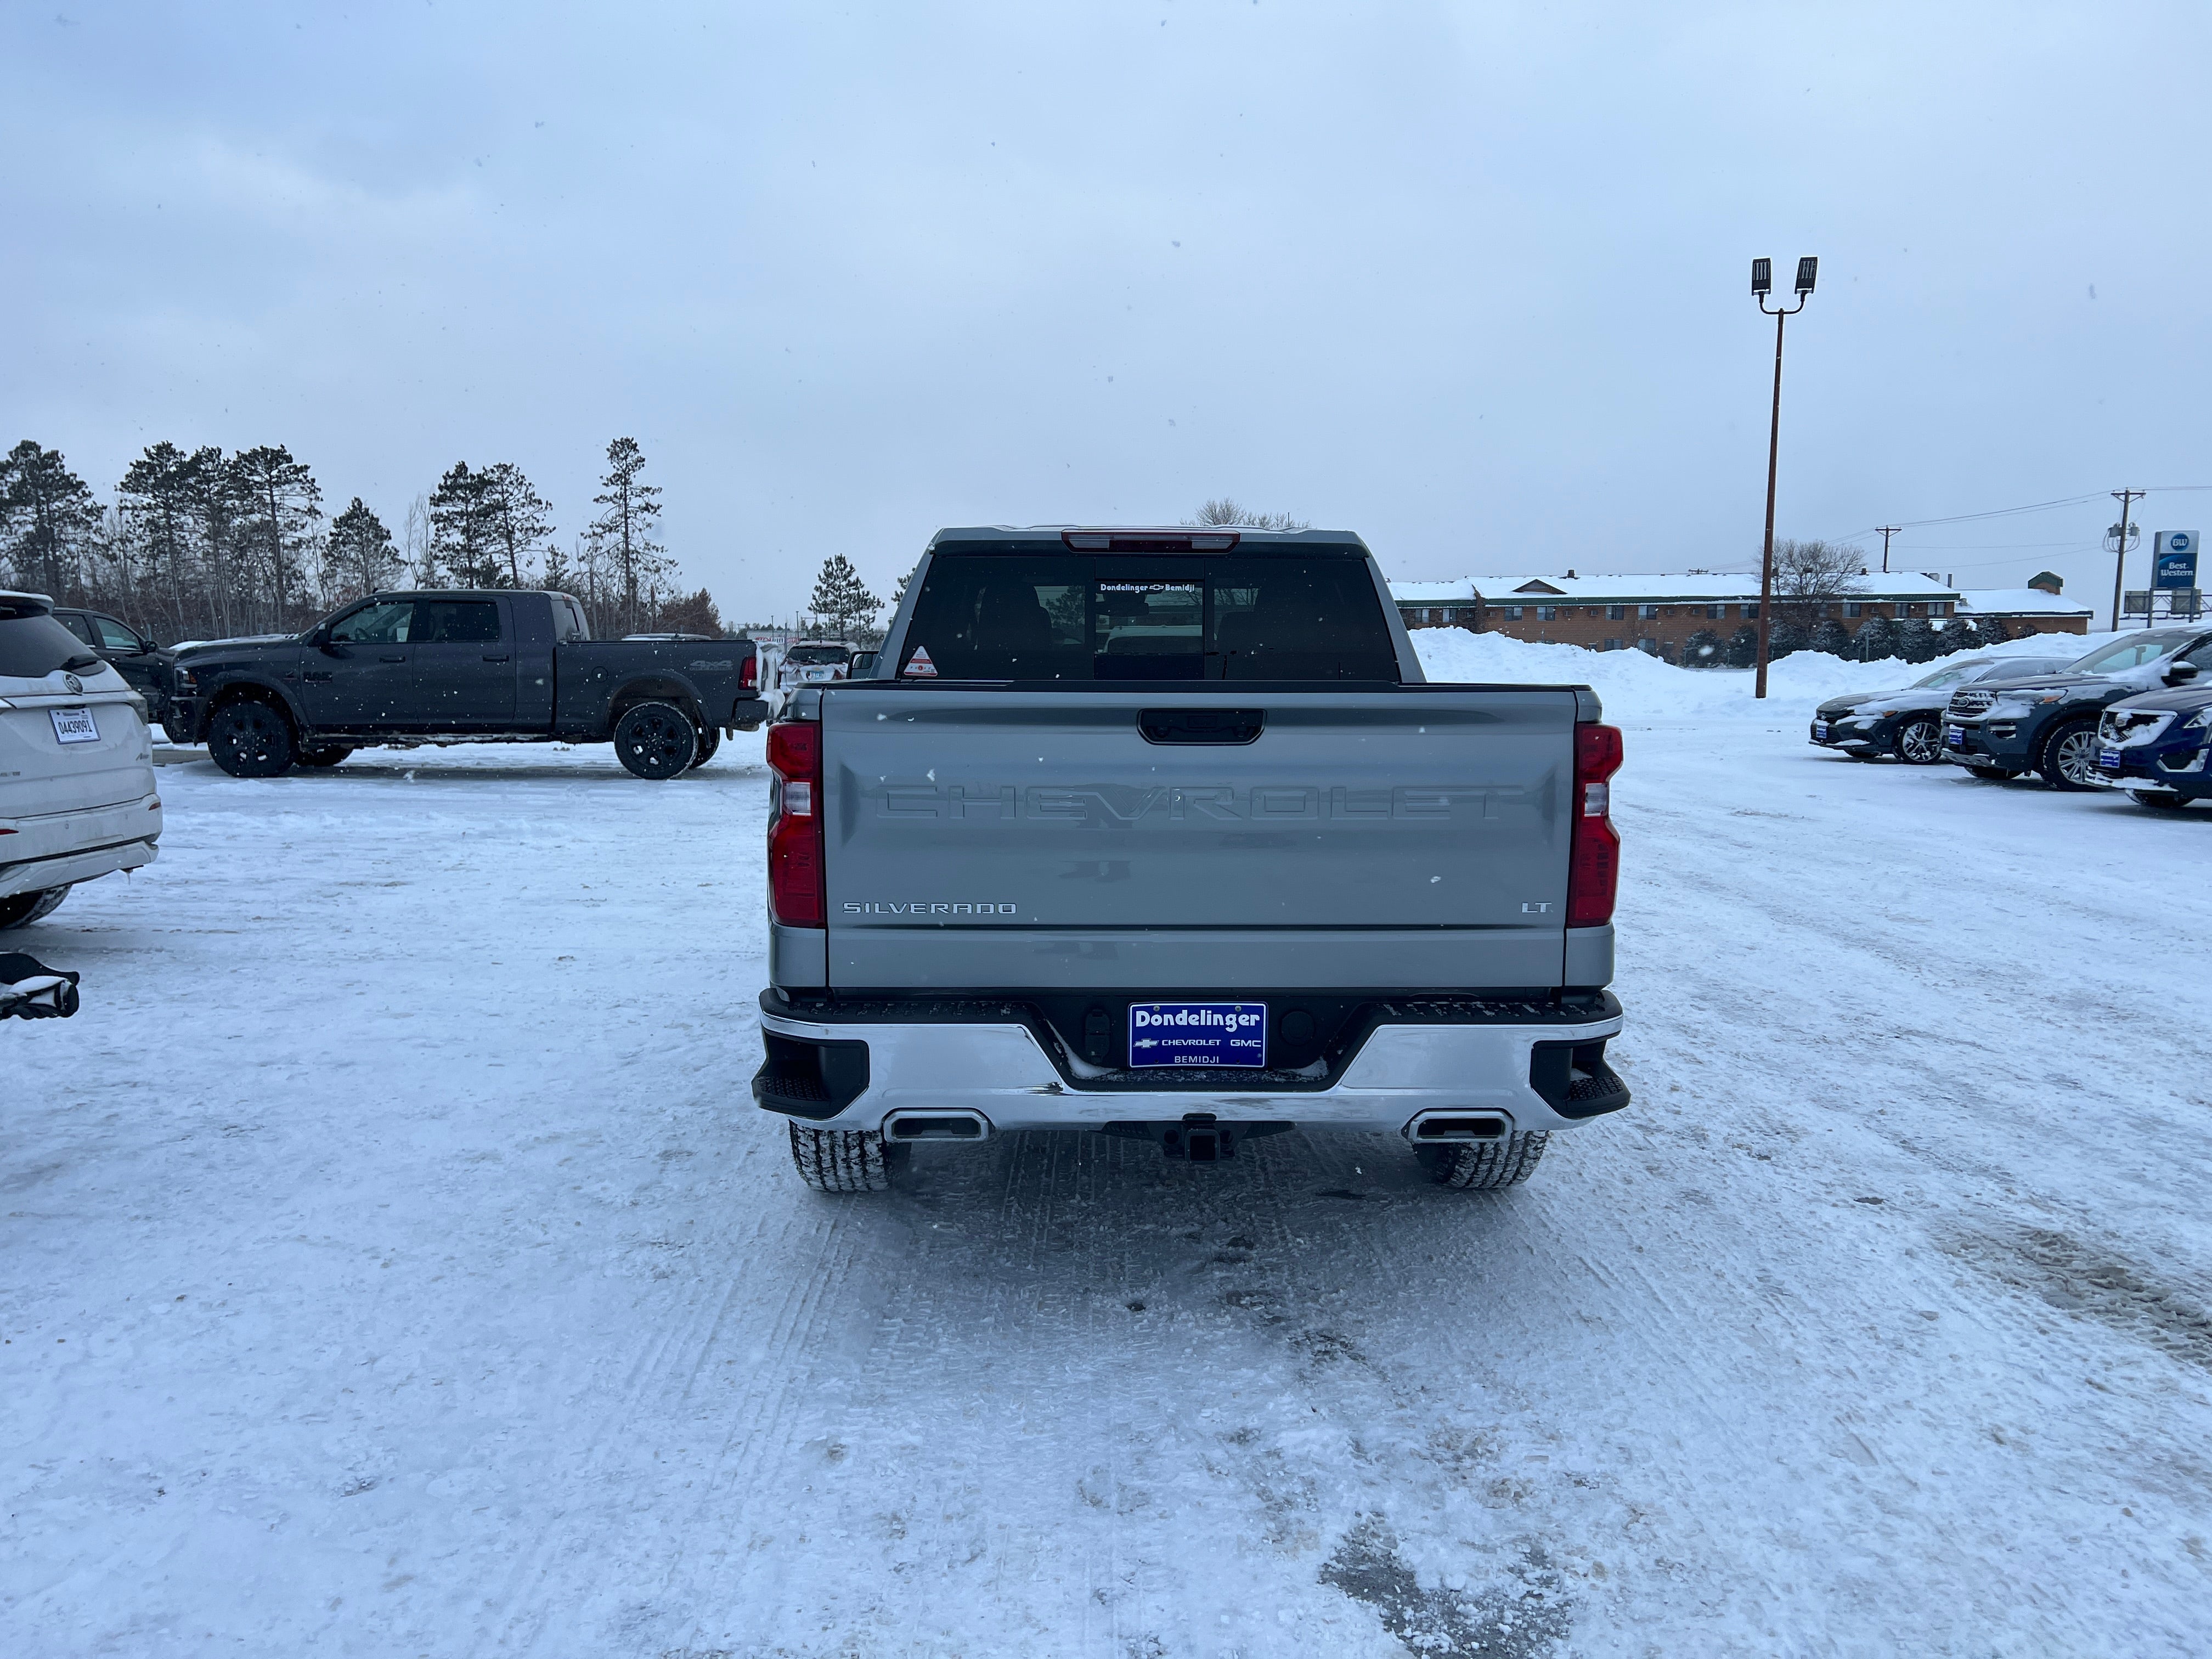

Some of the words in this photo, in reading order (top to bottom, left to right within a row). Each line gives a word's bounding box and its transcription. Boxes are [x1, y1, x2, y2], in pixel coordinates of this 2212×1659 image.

[1101, 584, 1148, 594] Dondelinger
[1165, 584, 1194, 593] Bemidji
[58, 720, 93, 734] 04439091
[877, 786, 1525, 820] CHEVROLET
[842, 902, 1018, 915] SILVERADO
[1521, 902, 1553, 913] LT
[1136, 1009, 1260, 1032] Dondelinger
[1230, 1039, 1261, 1047] GMC
